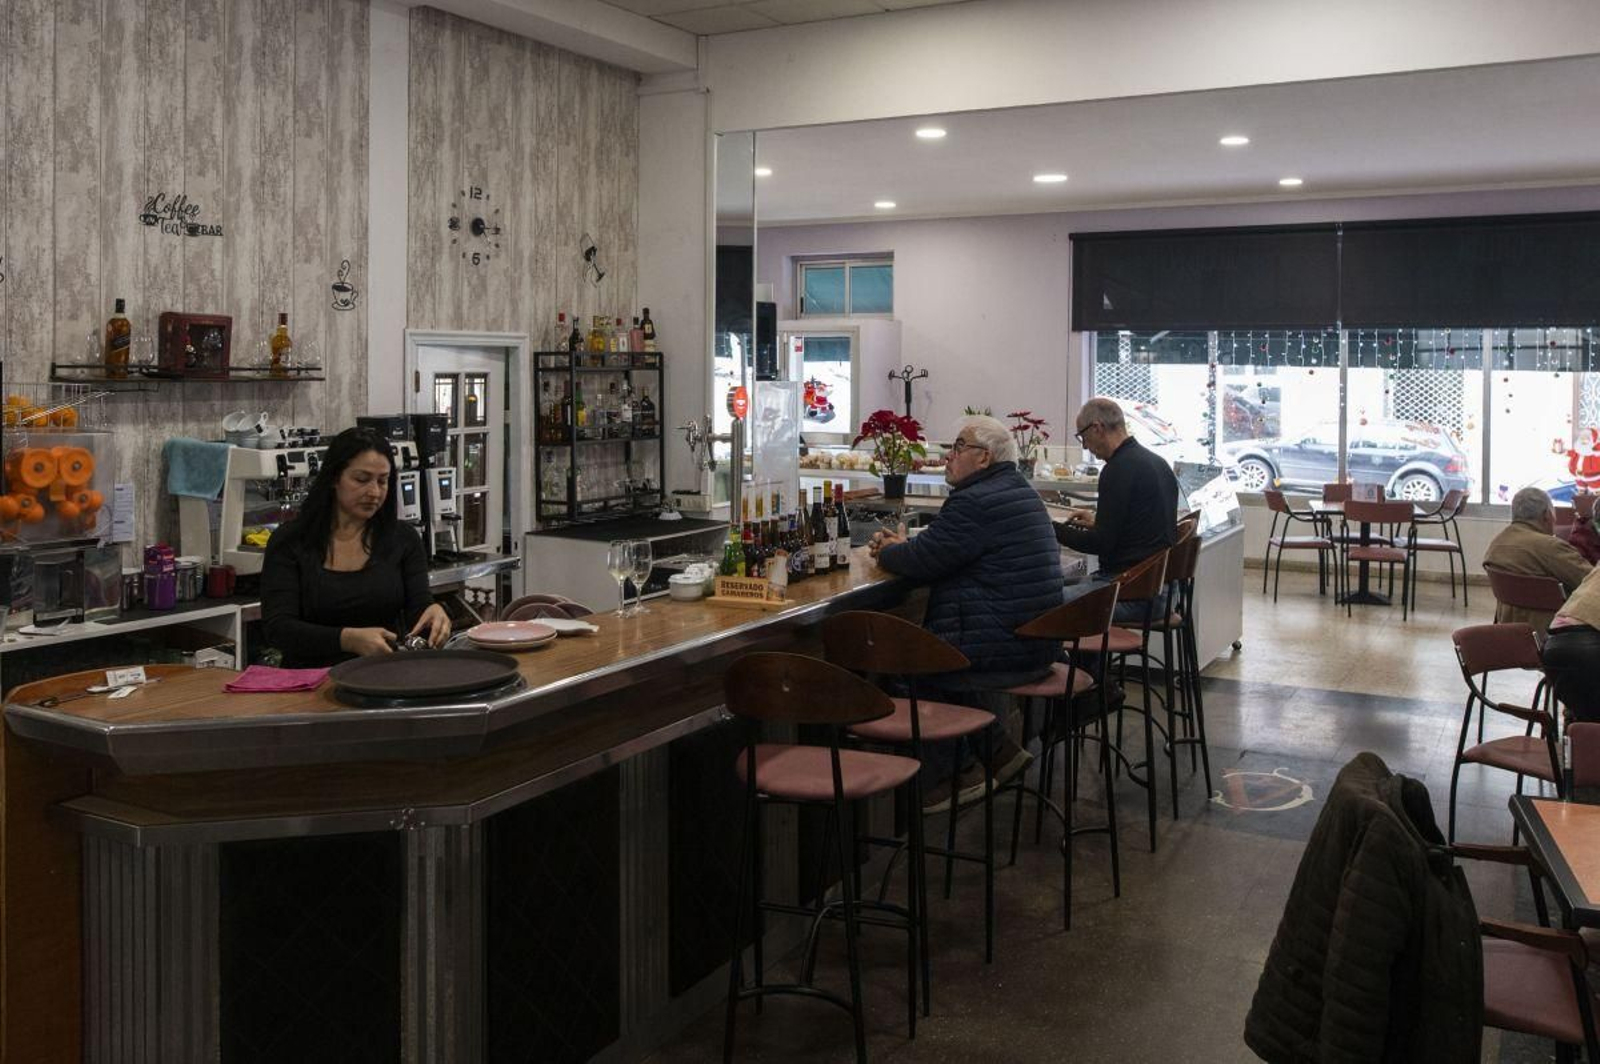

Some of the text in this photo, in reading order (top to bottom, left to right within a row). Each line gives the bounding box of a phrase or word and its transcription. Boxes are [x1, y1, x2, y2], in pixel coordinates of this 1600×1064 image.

[469, 186, 482, 200] 12
[154, 193, 200, 219] Coffee
[159, 217, 223, 236] Tea BAR
[472, 252, 480, 266] 6
[720, 580, 764, 591] RESERVADO
